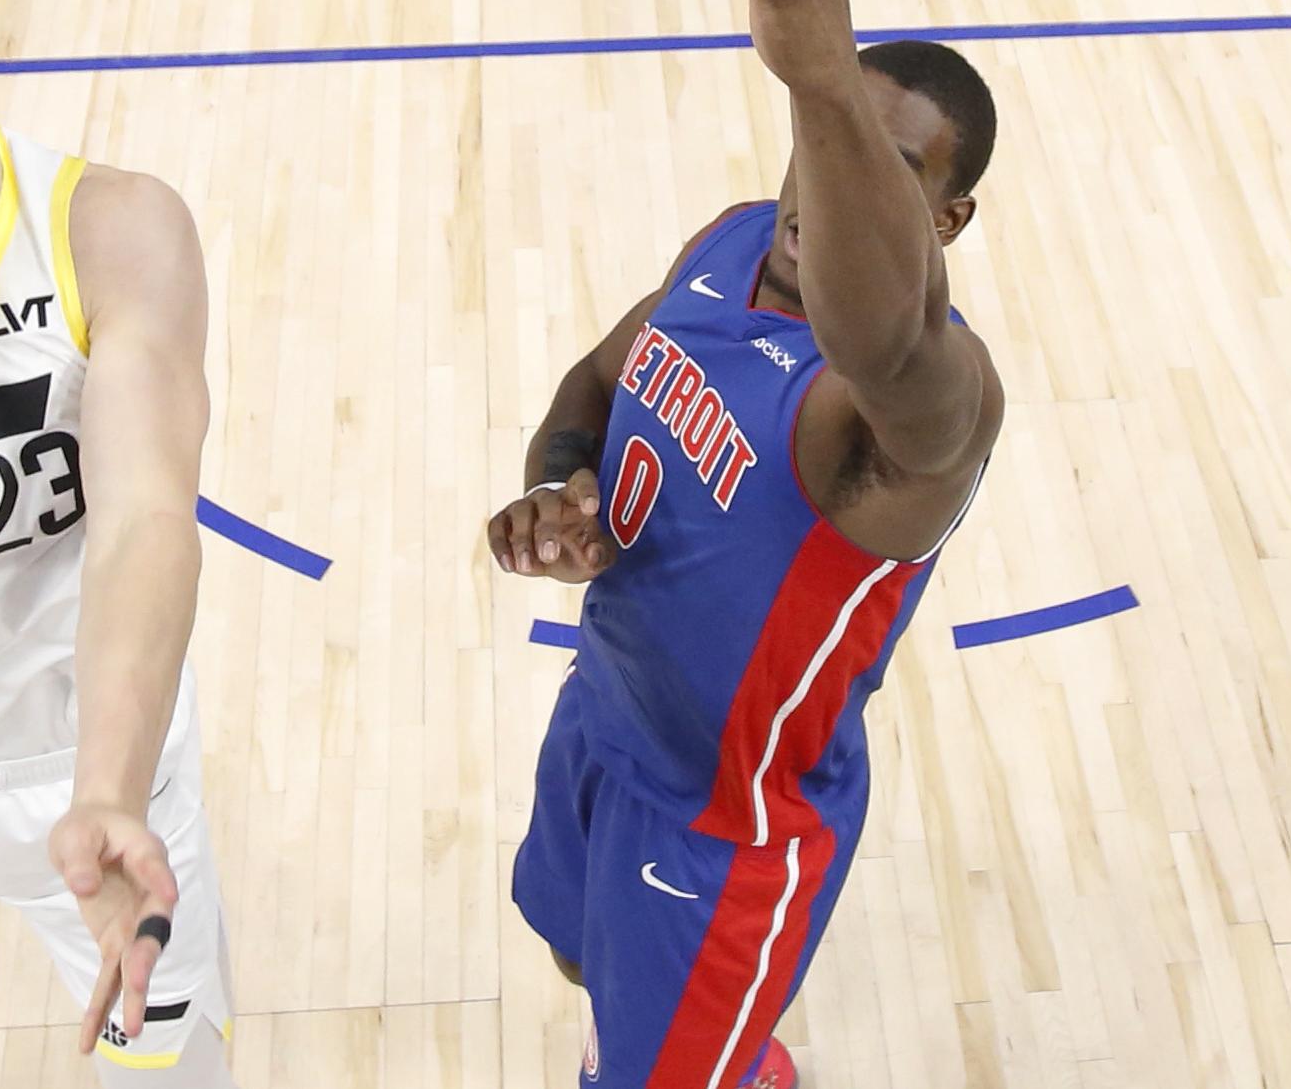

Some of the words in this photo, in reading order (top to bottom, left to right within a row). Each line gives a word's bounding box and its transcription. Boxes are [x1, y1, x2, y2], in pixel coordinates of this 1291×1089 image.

[751, 337, 798, 373] ockX
[618, 322, 759, 512] ETROIT
[609, 435, 664, 550] 0
